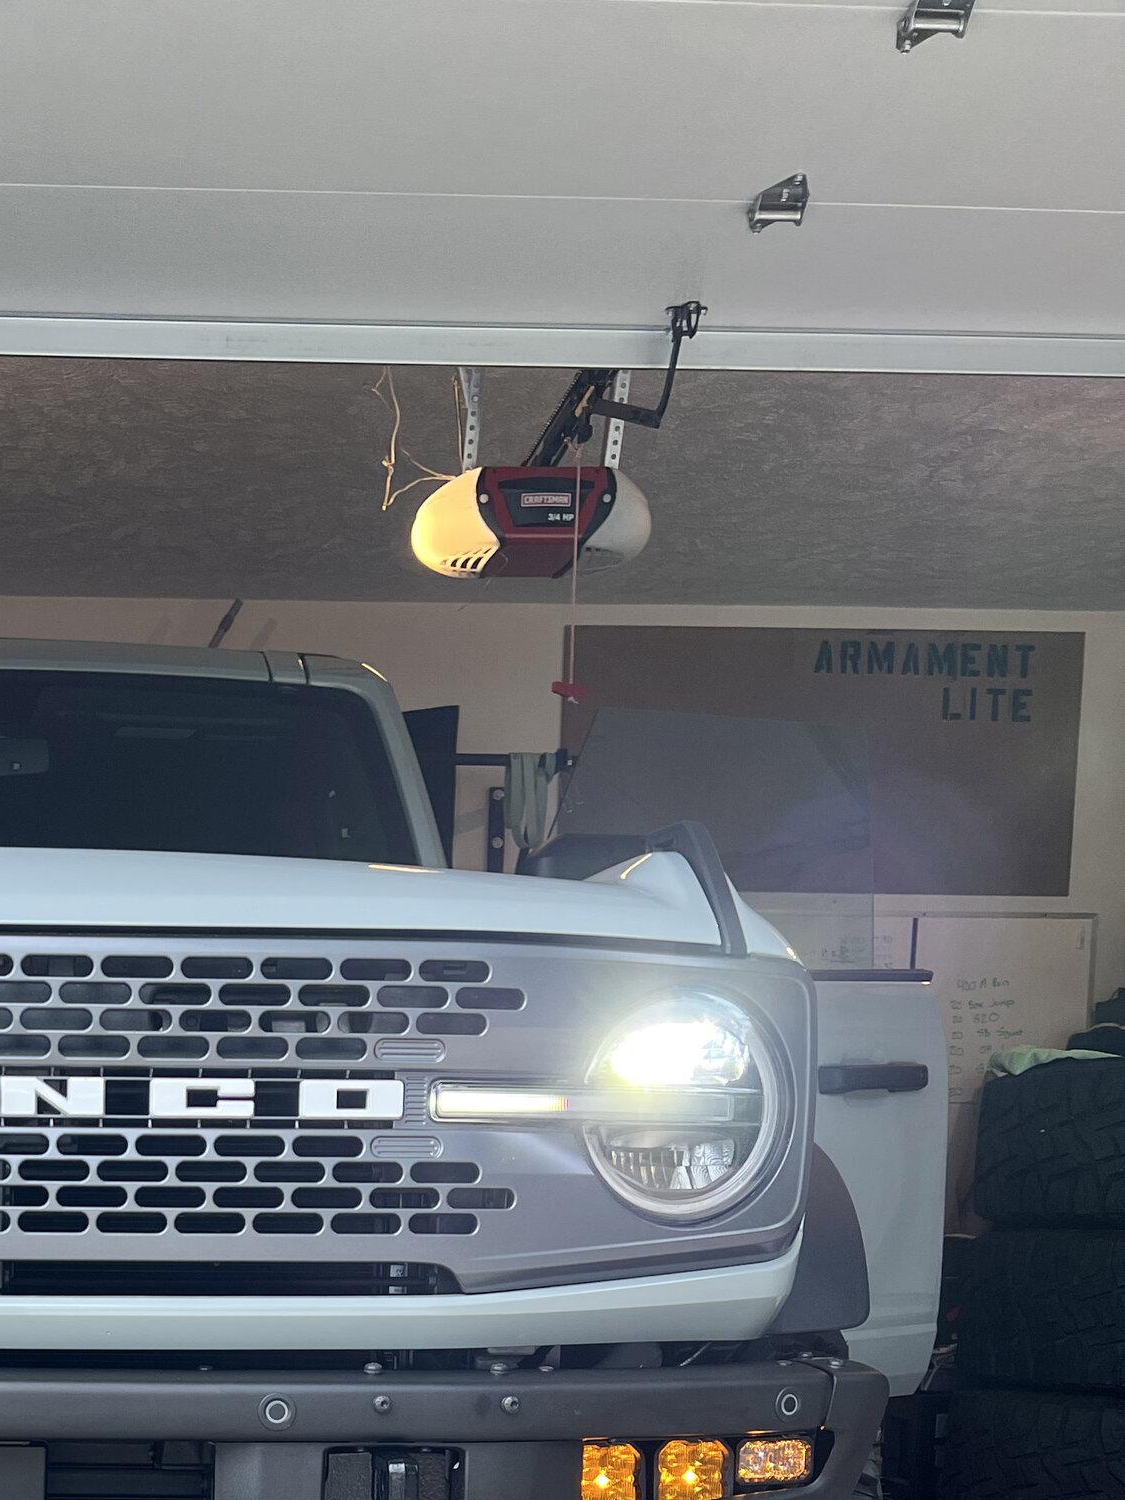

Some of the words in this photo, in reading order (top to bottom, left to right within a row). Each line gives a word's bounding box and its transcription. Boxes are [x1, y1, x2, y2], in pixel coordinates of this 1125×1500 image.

[524, 495, 569, 505] CRAFTSMAN
[547, 513, 561, 521] 3/4
[562, 513, 574, 521] HP
[814, 640, 1036, 679] ARMAMENT
[941, 687, 1033, 722] LITE
